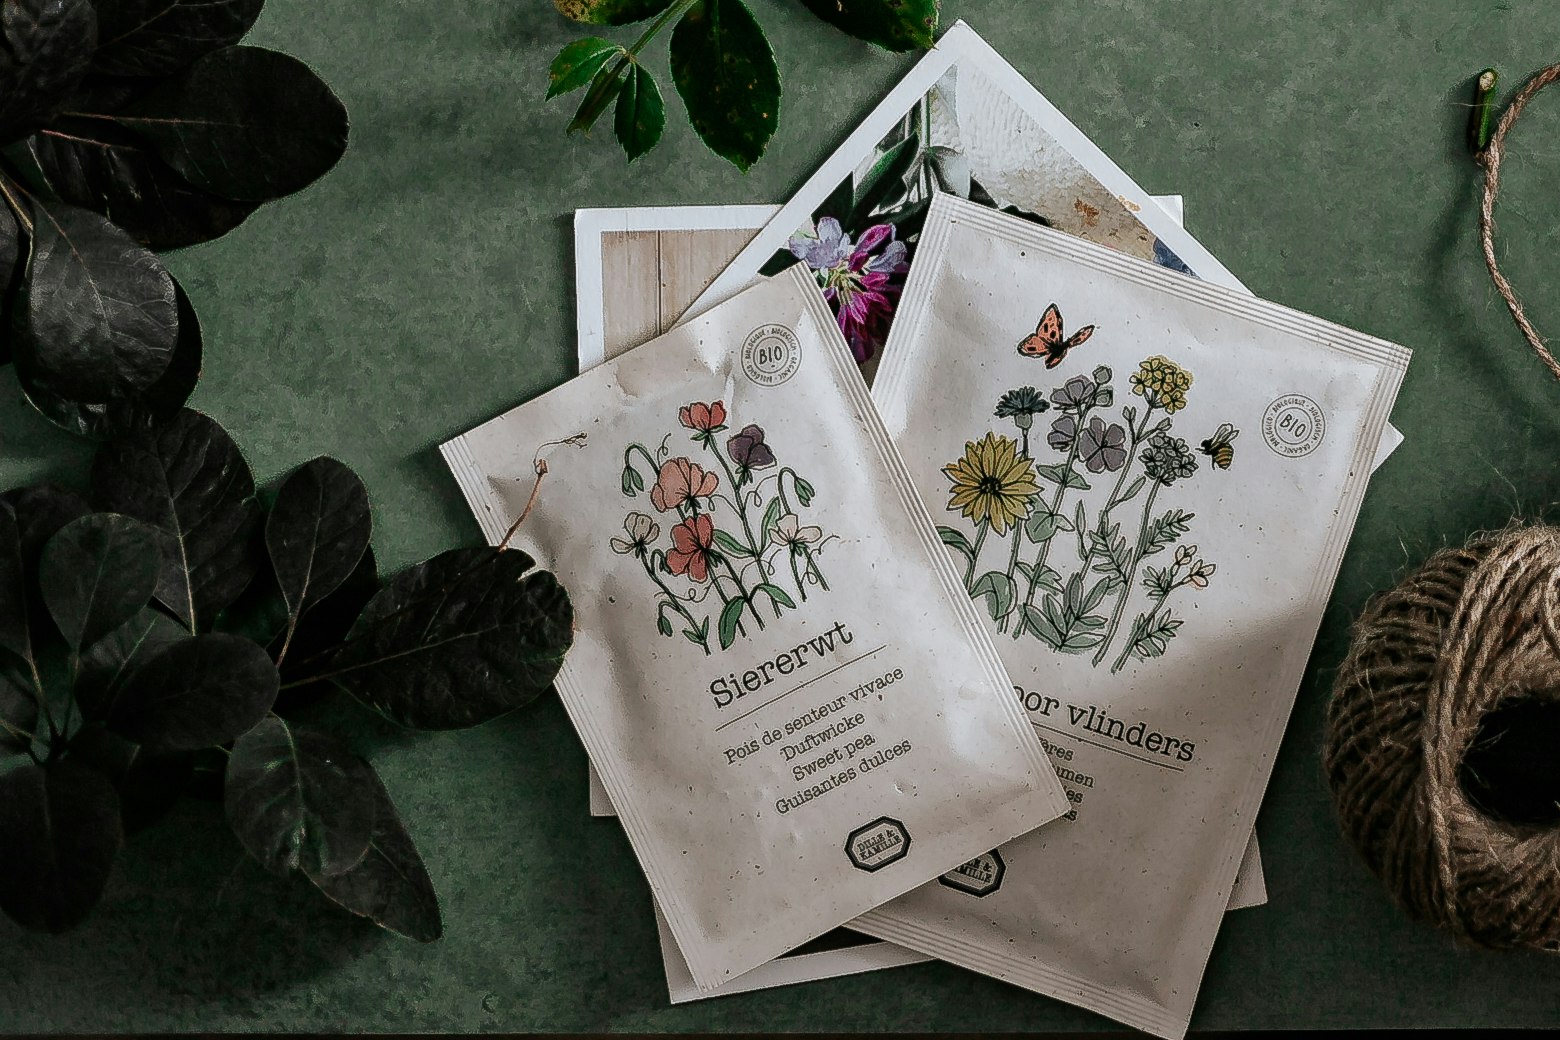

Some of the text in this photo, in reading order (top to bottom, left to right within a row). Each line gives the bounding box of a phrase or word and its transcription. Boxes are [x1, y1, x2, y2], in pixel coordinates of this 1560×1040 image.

[759, 345, 783, 365] BIO
[1279, 413, 1306, 438] BIO
[709, 620, 854, 709] Siererwt
[723, 667, 904, 765] Pois de senteur vivace
[779, 712, 866, 761] Duftwicke
[1067, 704, 1196, 762] vlinders
[775, 739, 912, 814] Guisantes dulces
[792, 733, 876, 782] Sweet pea
[857, 828, 896, 851] DILLE &
[859, 834, 903, 861] KAMILLE
